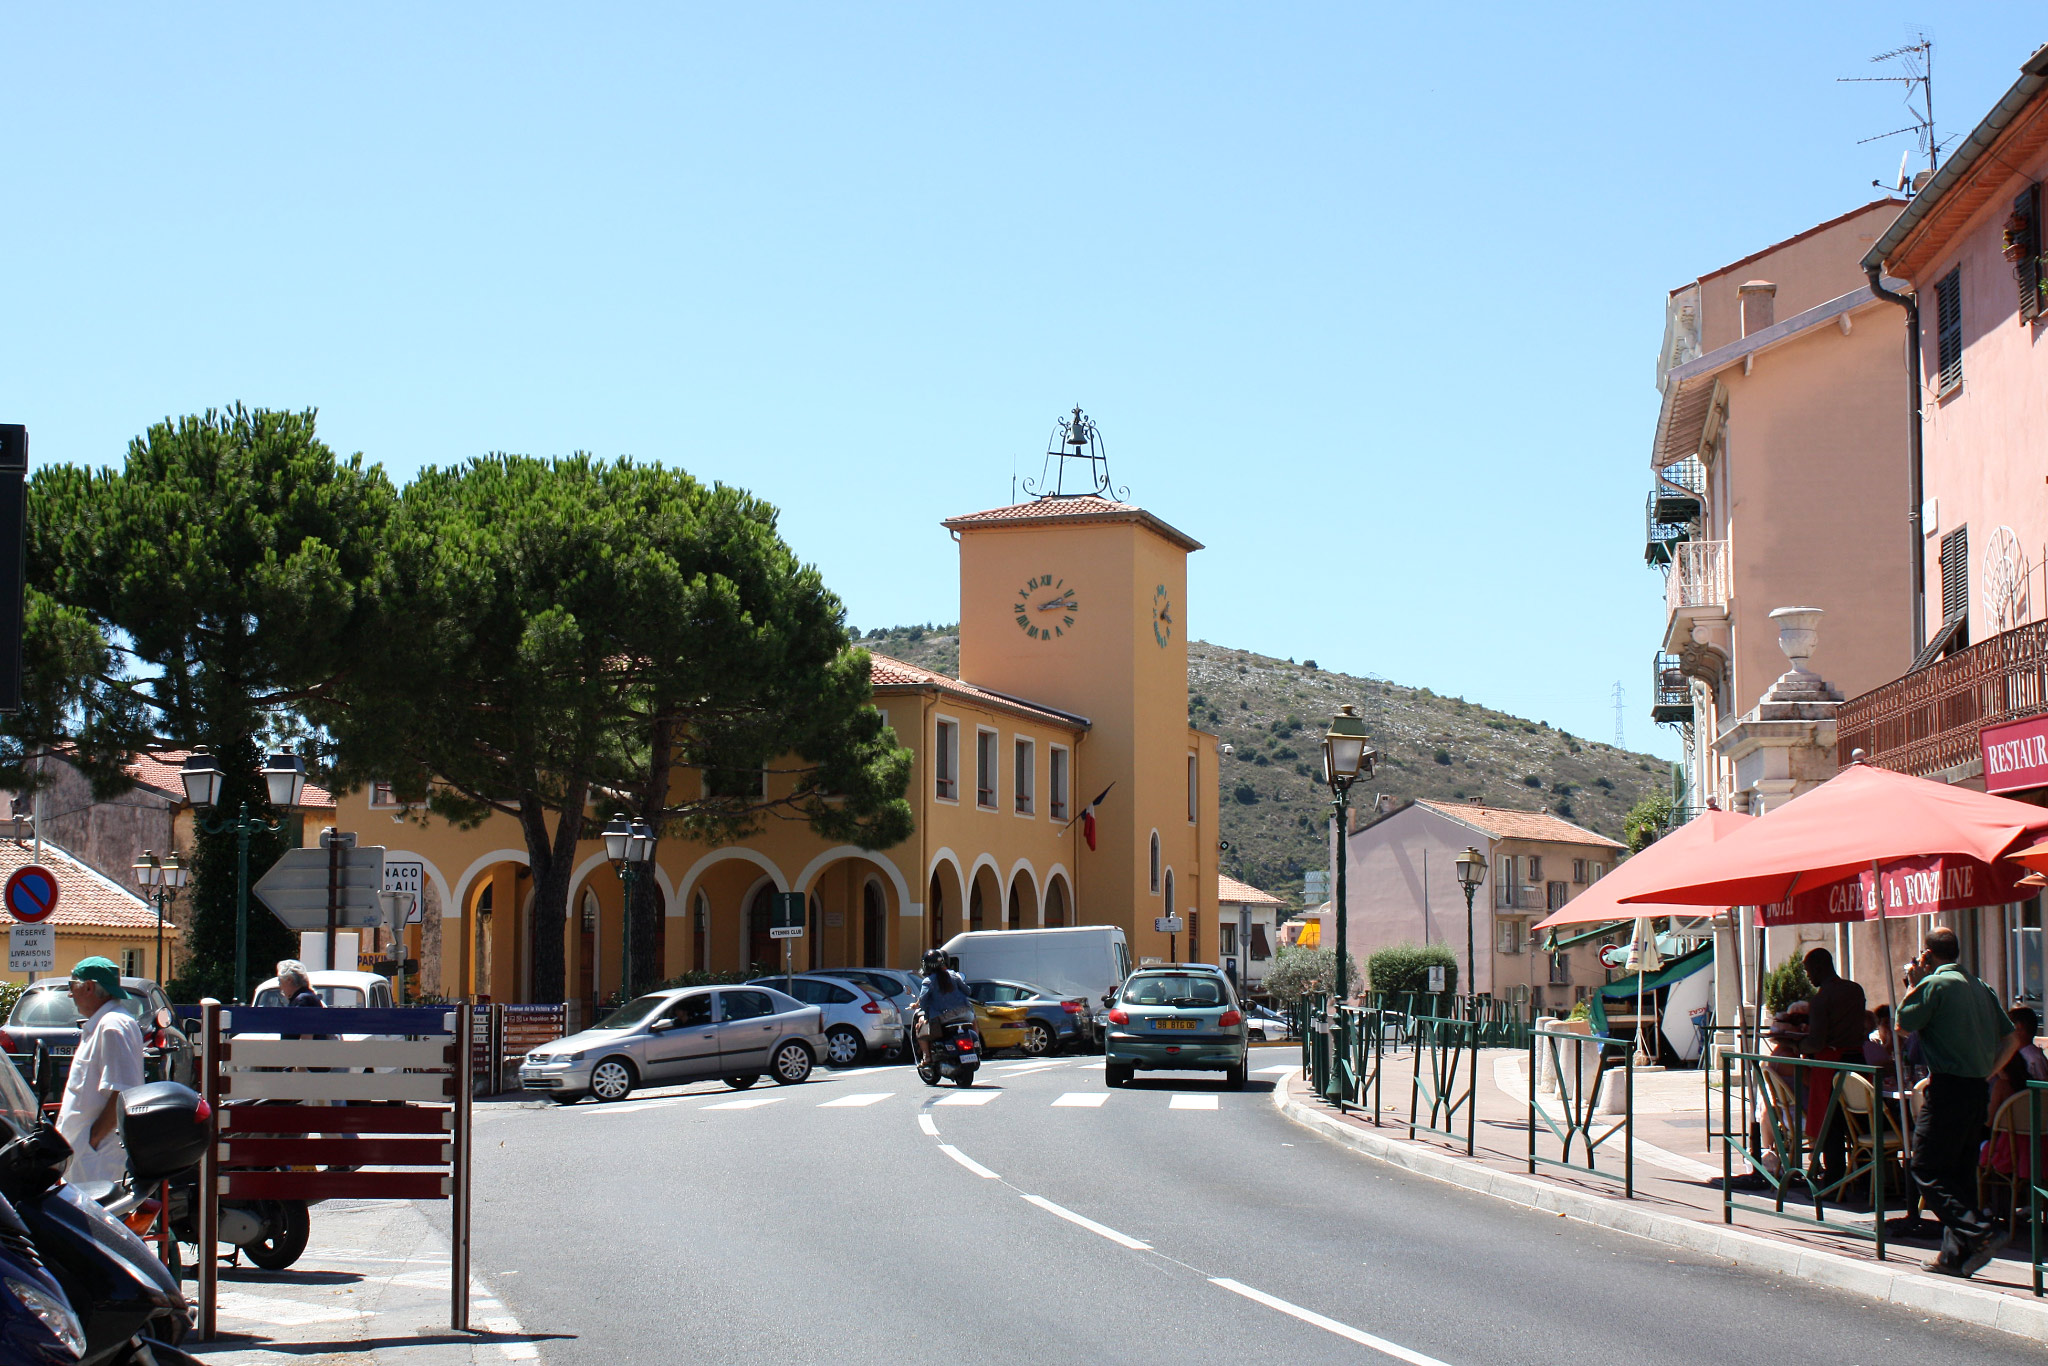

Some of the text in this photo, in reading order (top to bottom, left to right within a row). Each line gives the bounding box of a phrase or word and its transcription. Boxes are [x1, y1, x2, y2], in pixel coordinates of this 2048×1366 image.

[385, 868, 418, 878] NACO
[1867, 882, 1885, 911] d
[1889, 877, 1903, 908] la
[15, 928, 47, 937] RÉSERVÉ
[24, 939, 38, 947] AUX
[11, 949, 52, 958] LIVRAISONS
[10, 960, 20, 968] DE
[357, 954, 389, 967] PARKI
[55, 1047, 72, 1055] 198
